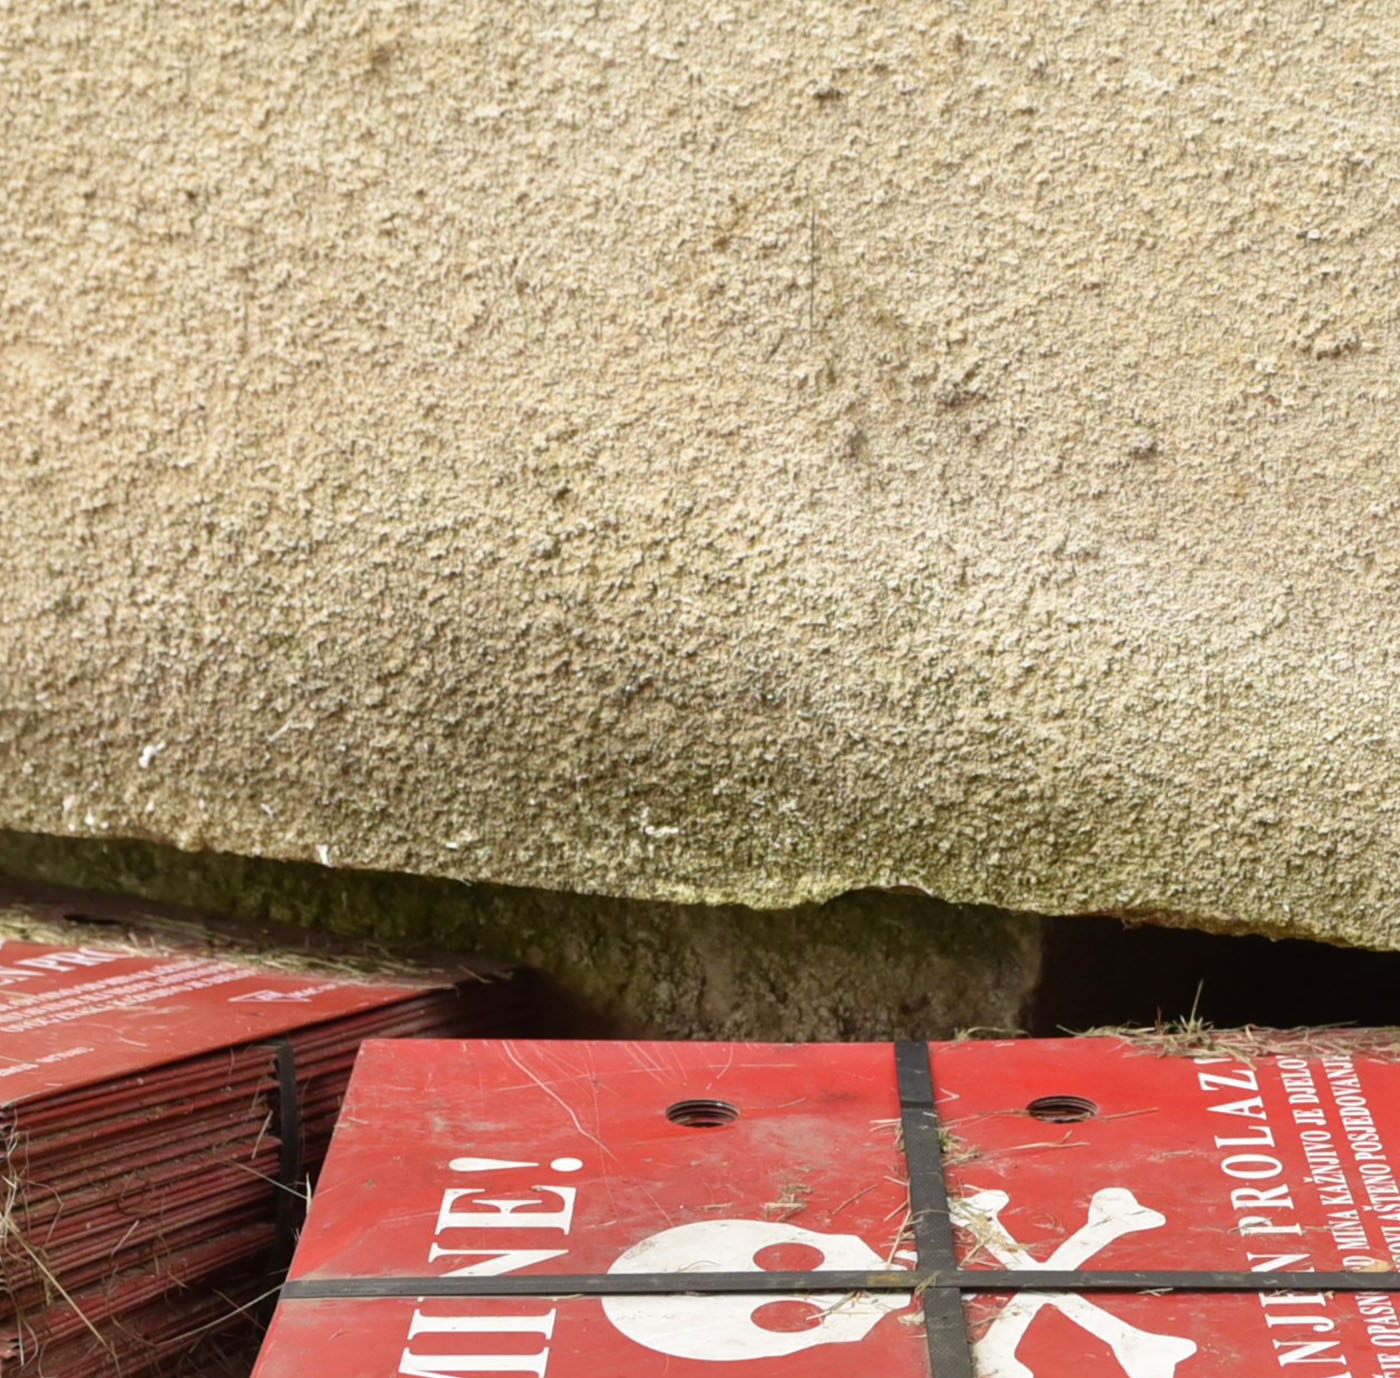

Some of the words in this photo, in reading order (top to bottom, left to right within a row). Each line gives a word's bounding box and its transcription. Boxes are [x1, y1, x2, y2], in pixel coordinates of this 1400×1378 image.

[1291, 1108, 1328, 1125] JE
[1299, 1129, 1355, 1205] KAŽNJIVO
[1324, 1209, 1370, 1249] MINA
